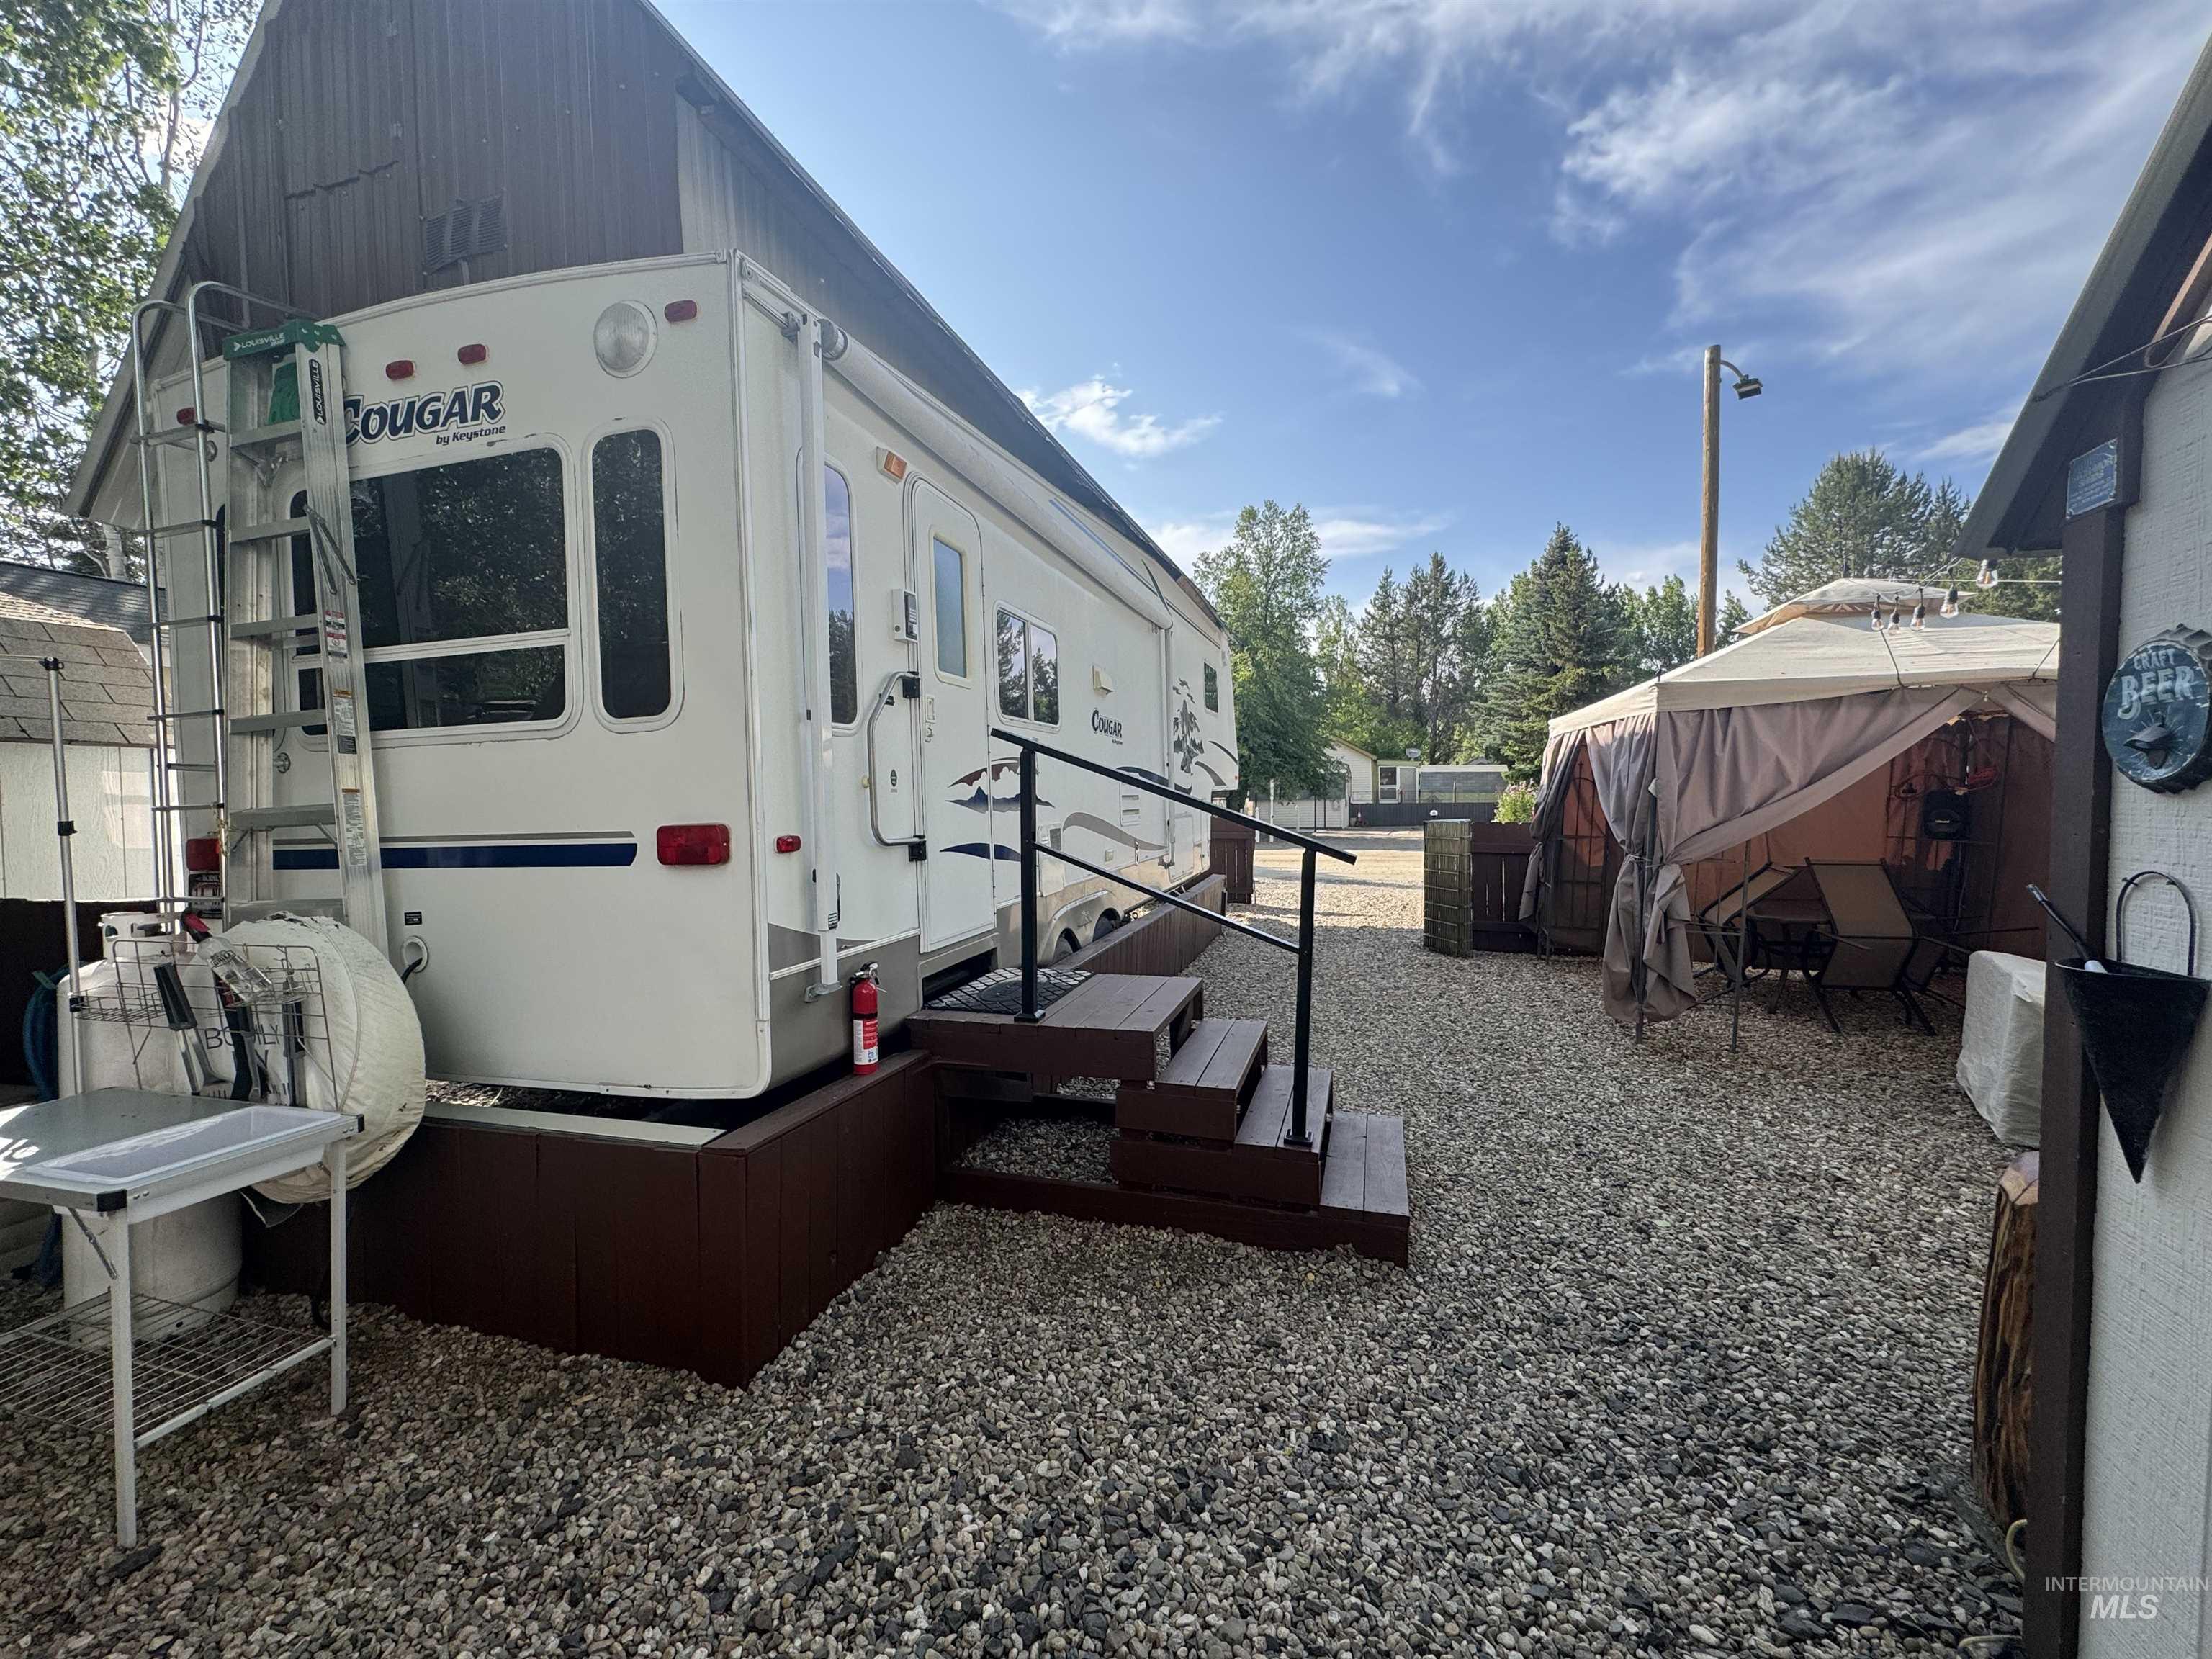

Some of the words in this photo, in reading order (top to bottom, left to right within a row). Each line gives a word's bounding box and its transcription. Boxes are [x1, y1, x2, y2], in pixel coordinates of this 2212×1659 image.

[240, 332, 286, 349] LOUISVILLE
[310, 361, 323, 416] LOUISVILLE
[343, 381, 505, 446] COUGAR
[436, 433, 449, 446] by
[451, 425, 506, 443] Keystone
[2133, 649, 2175, 670] CRAFT
[2117, 665, 2195, 720] BEER
[1092, 709, 1123, 738] COUGAR
